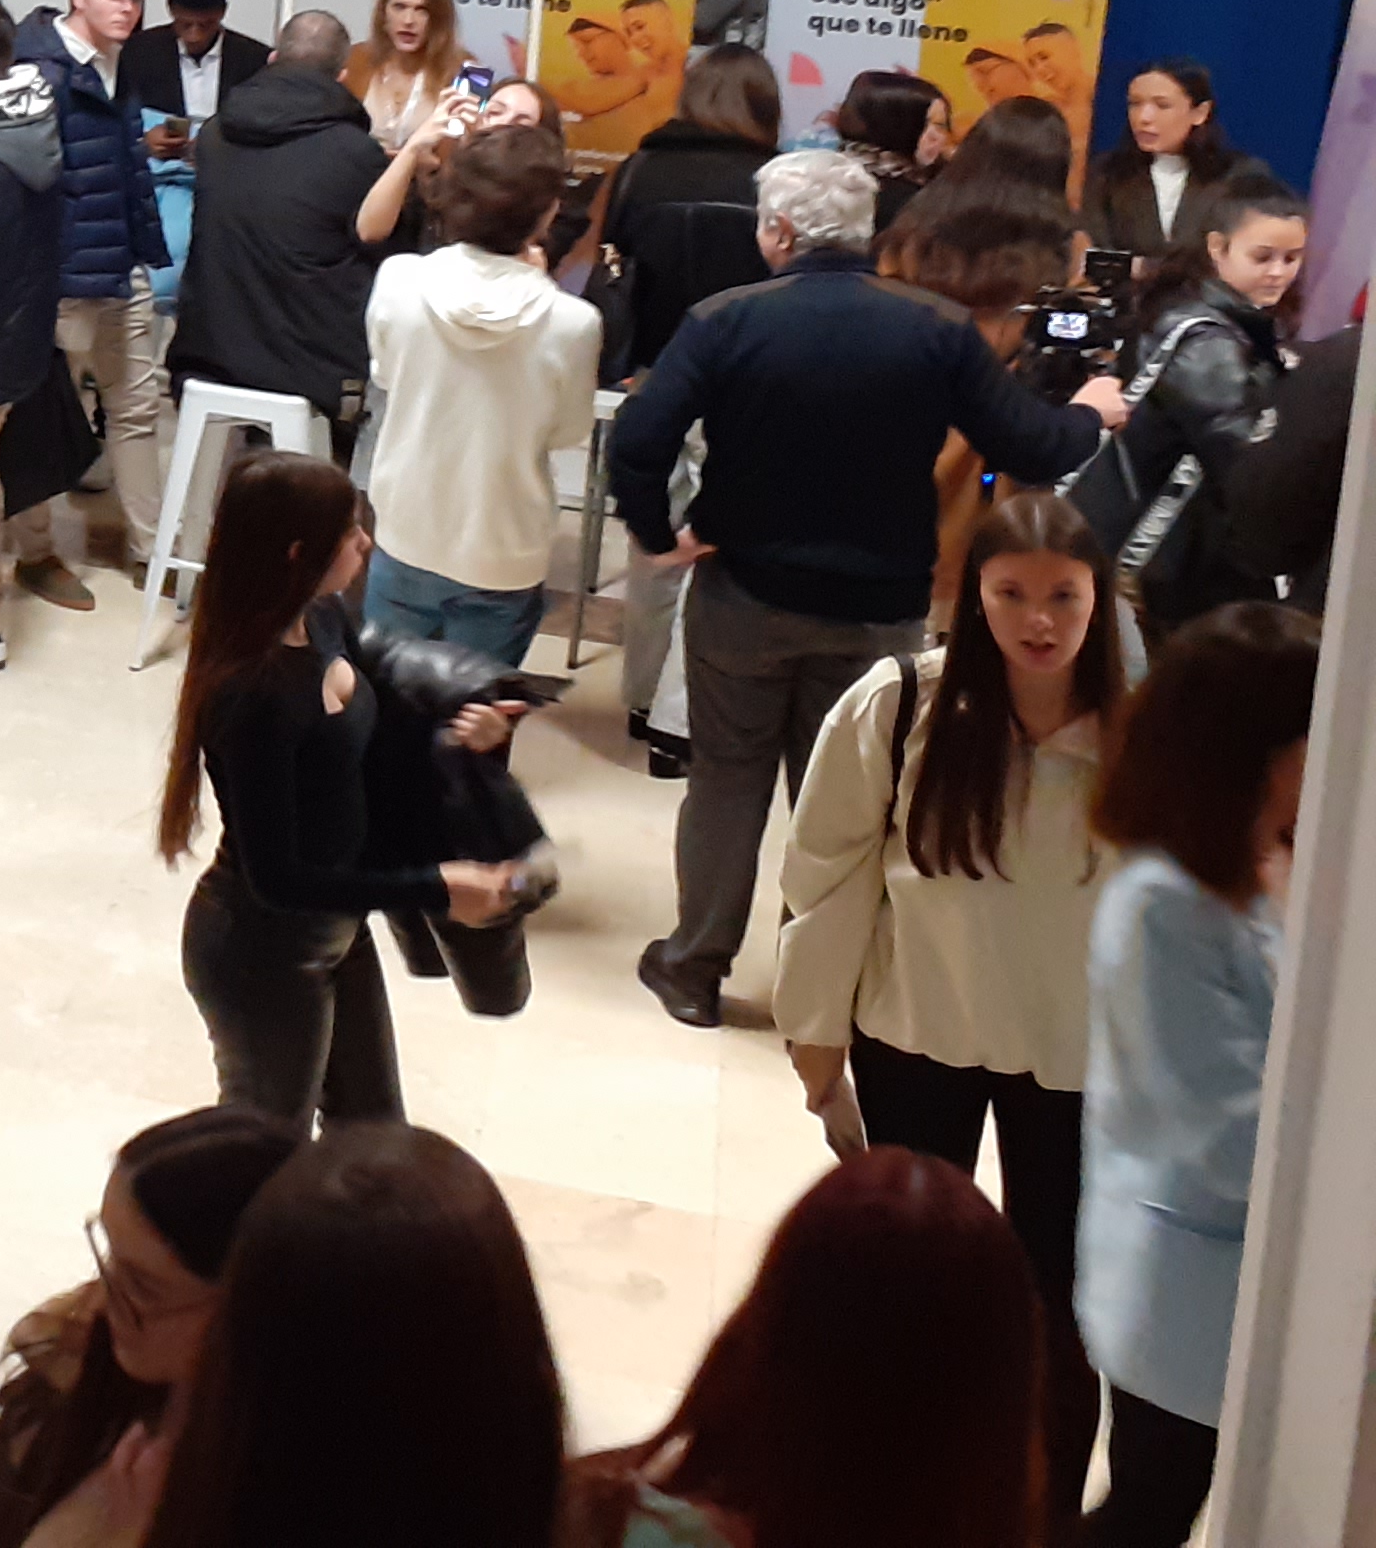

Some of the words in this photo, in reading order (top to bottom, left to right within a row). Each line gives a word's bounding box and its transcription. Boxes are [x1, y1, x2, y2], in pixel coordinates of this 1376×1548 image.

[807, 15, 860, 38] que
[866, 16, 894, 36] te
[899, 18, 969, 43] llene
